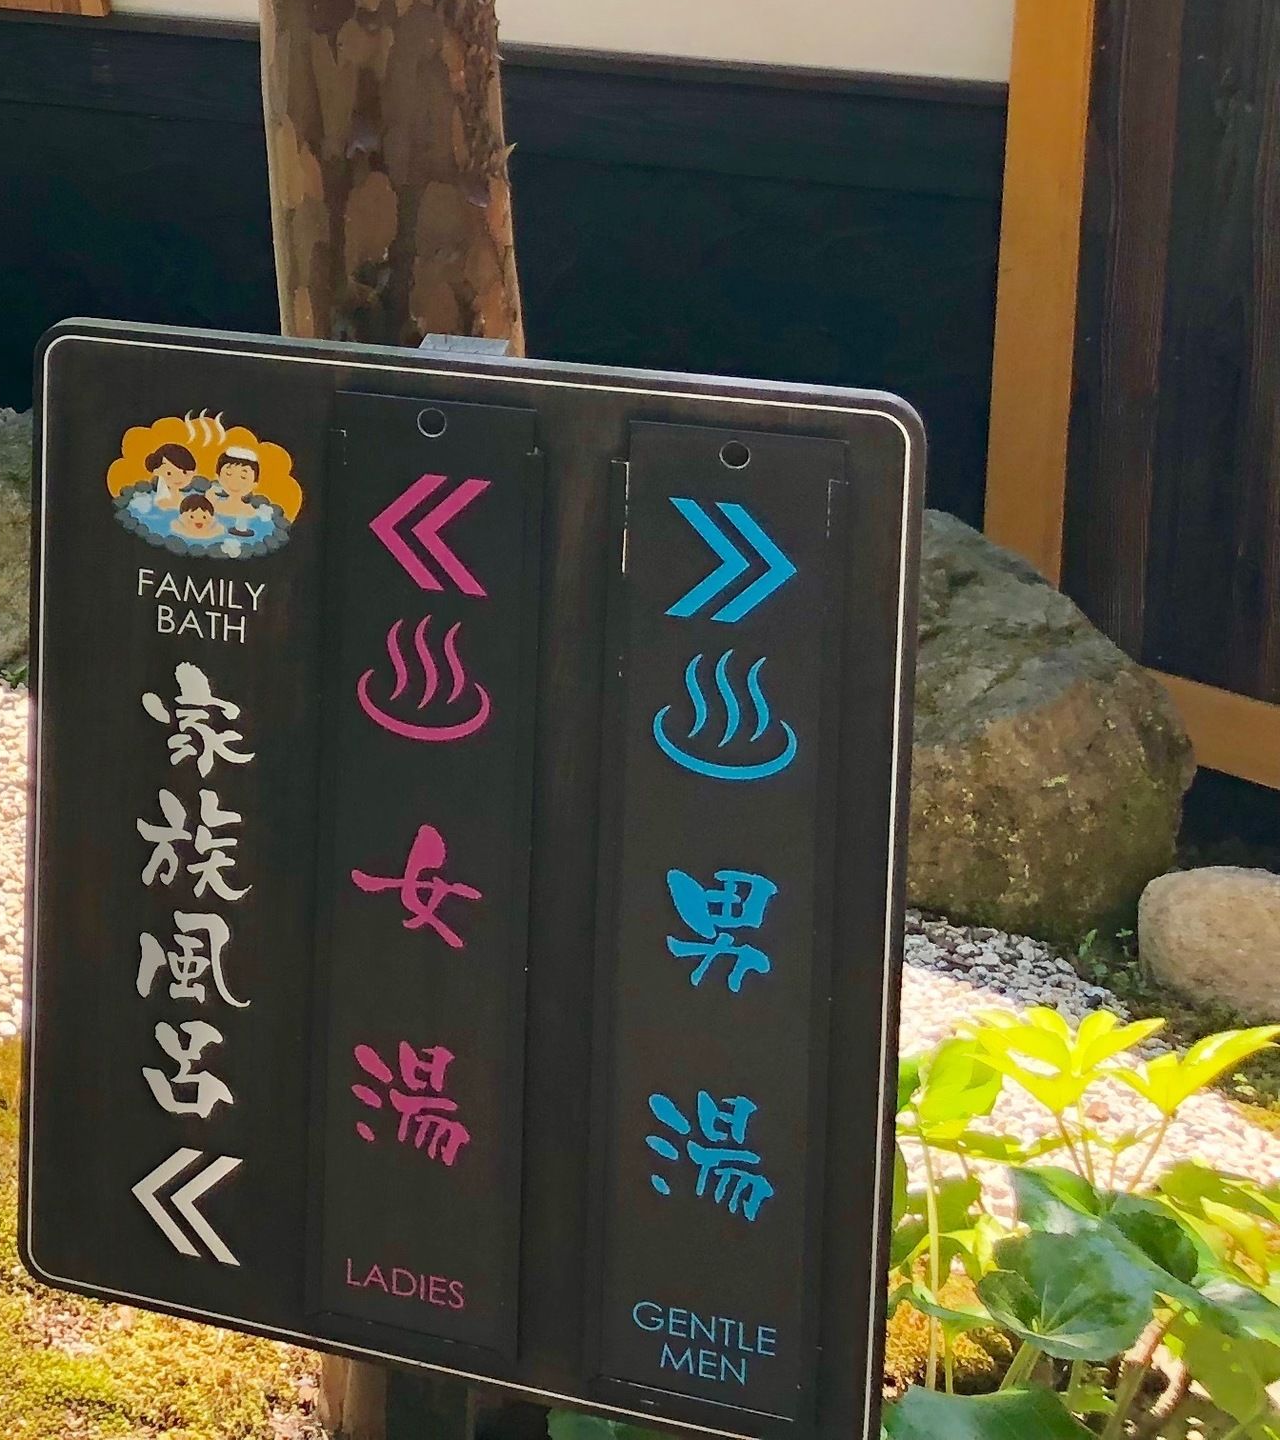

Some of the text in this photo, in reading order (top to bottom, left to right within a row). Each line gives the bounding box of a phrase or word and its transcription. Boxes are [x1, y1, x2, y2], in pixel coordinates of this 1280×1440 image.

[137, 568, 266, 612] FAMILY
[157, 604, 246, 644] BATH
[136, 661, 256, 1119] 家族風呂
[351, 824, 482, 1166] 女湯
[645, 868, 779, 1224] 男湯
[345, 1257, 466, 1310] LADIES
[631, 1299, 778, 1357] GENTLE
[659, 1342, 748, 1387] MEN
